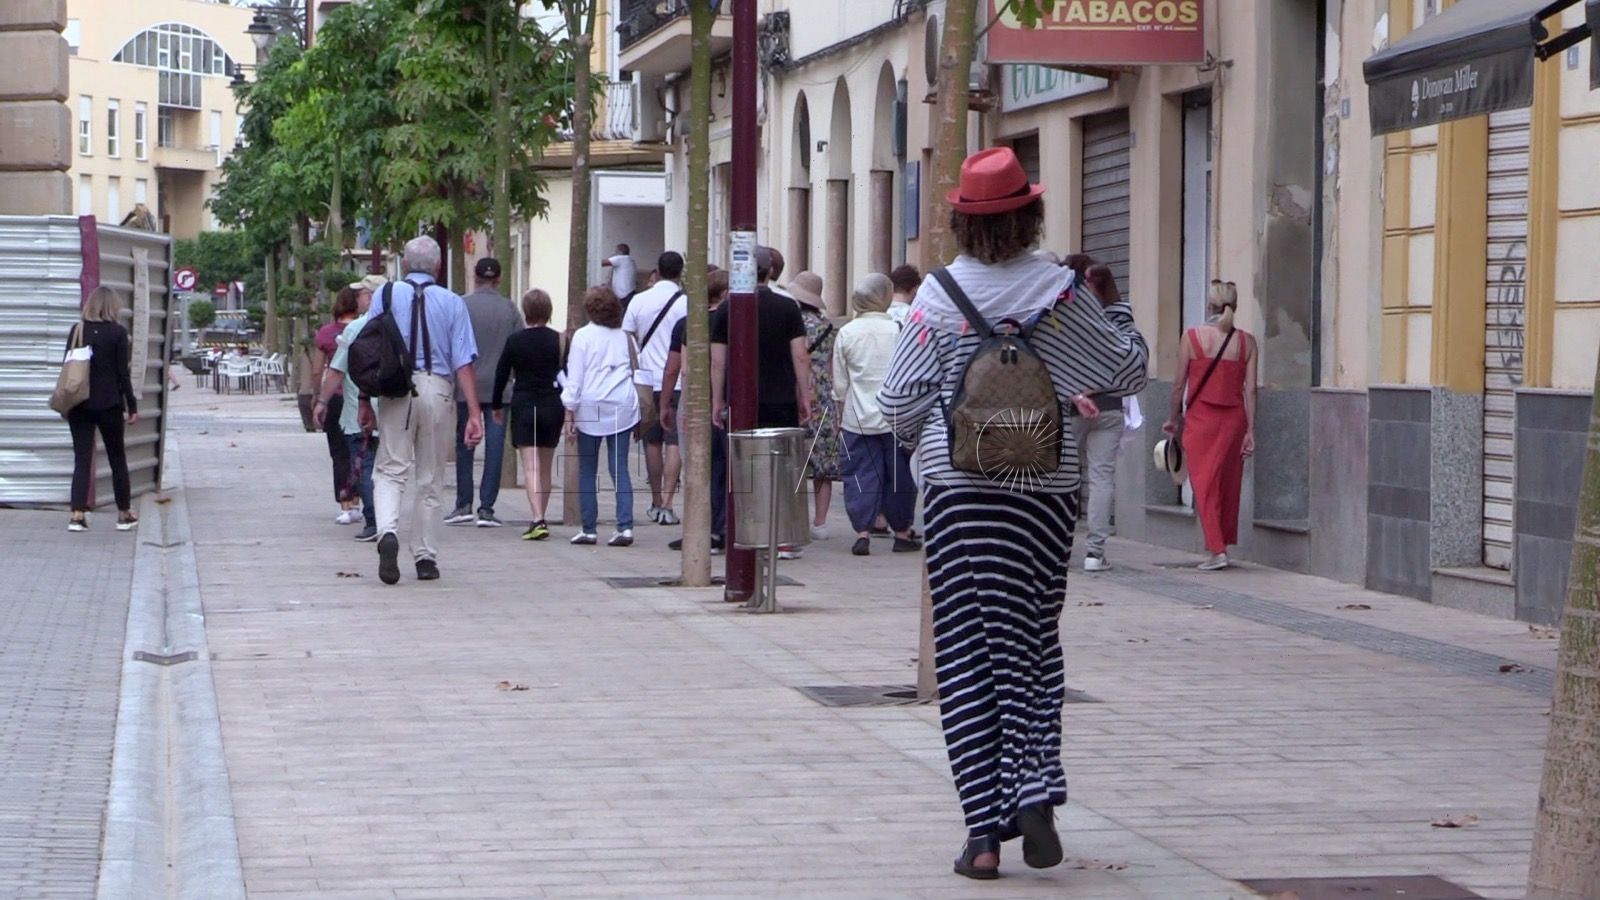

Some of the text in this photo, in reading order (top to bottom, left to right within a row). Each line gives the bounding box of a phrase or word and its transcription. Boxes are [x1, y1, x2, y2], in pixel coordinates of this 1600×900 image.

[1052, 1, 1199, 24] TABACOS
[1422, 64, 1478, 99] Donovan Miller
